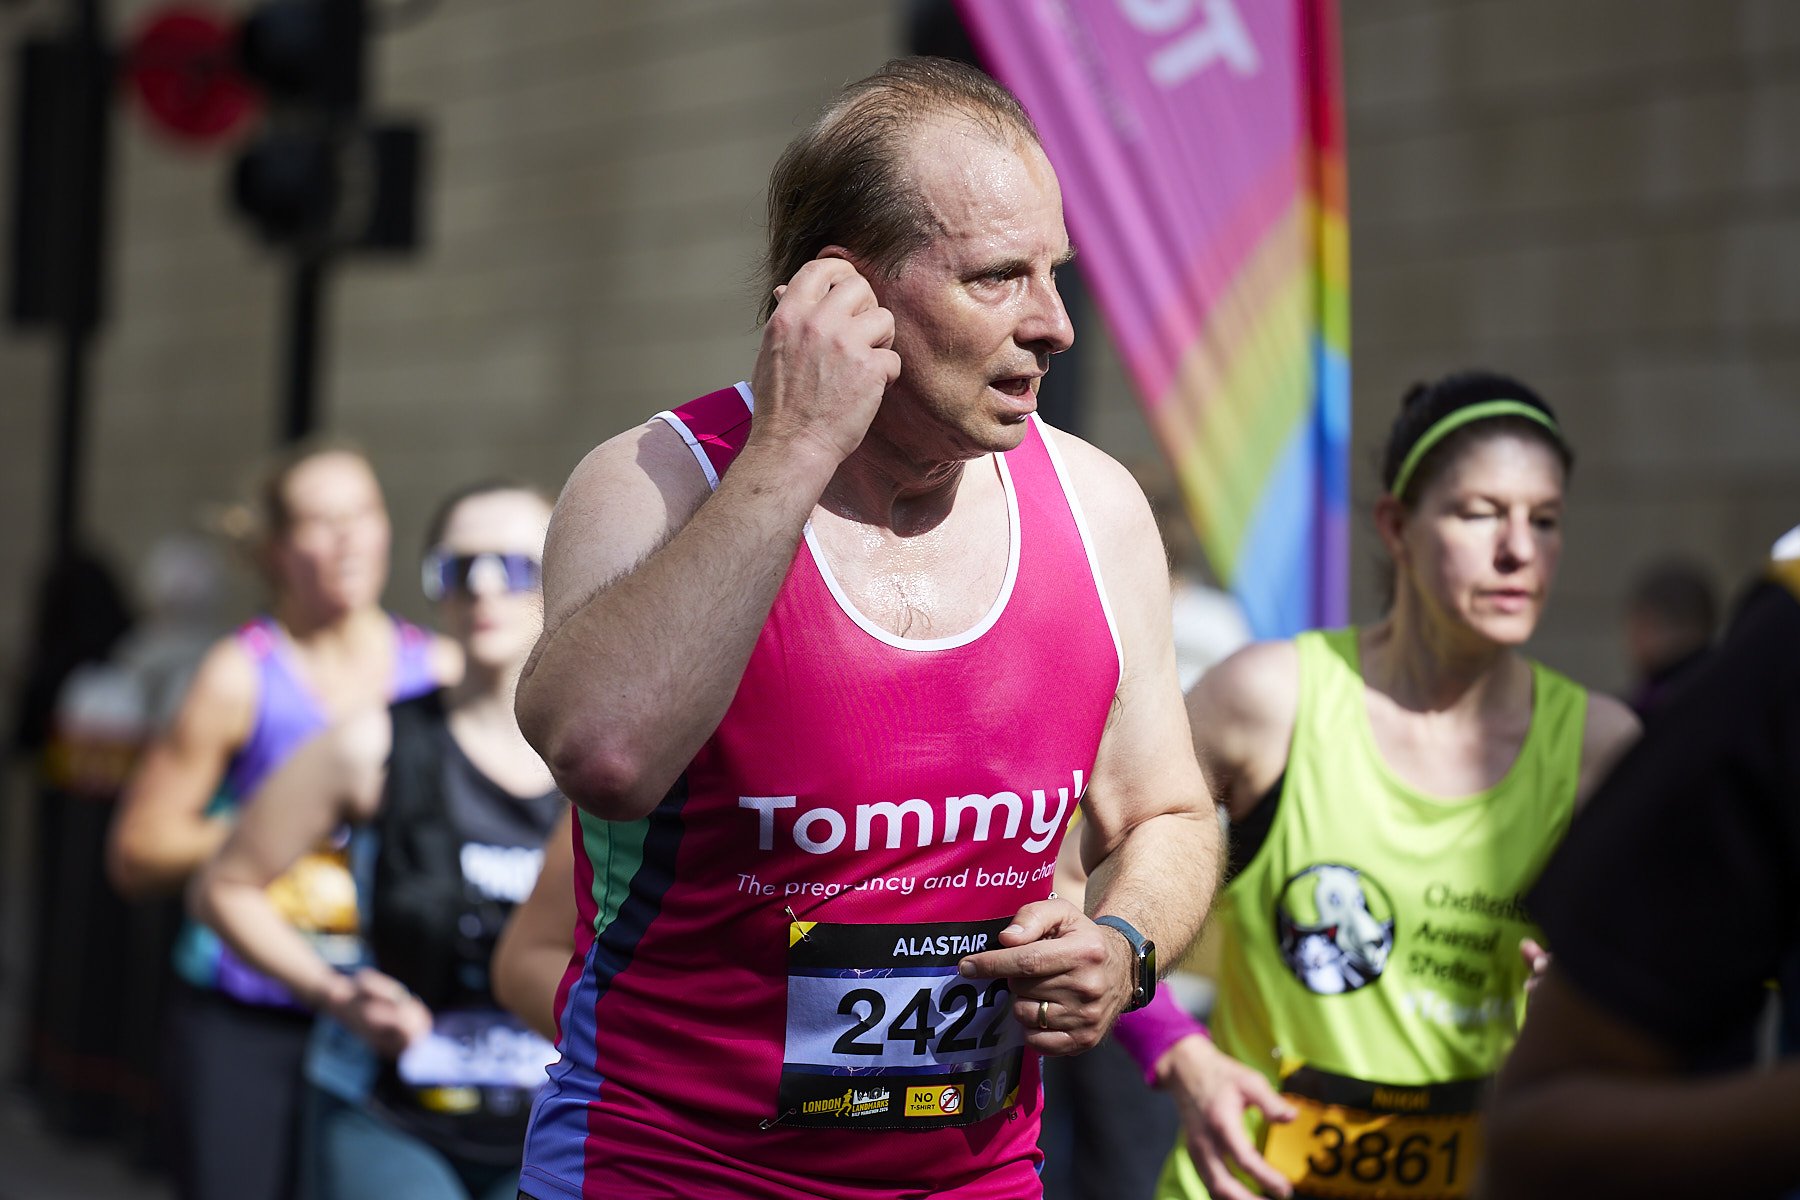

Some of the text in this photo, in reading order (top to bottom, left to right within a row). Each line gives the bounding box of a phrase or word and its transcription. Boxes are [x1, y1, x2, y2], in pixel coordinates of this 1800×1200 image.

[738, 769, 1088, 855] Tommy'
[737, 873, 776, 896] The
[924, 873, 967, 890] and
[975, 865, 1029, 889] baby
[1032, 857, 1057, 882] char
[892, 933, 988, 957] ALASTAIR
[802, 1097, 842, 1114] LONDON
[851, 1099, 889, 1113] LANDMARKS
[910, 1103, 936, 1111] T-SHIRT
[913, 1092, 934, 1103] NO
[1306, 1124, 1462, 1186] 3861
